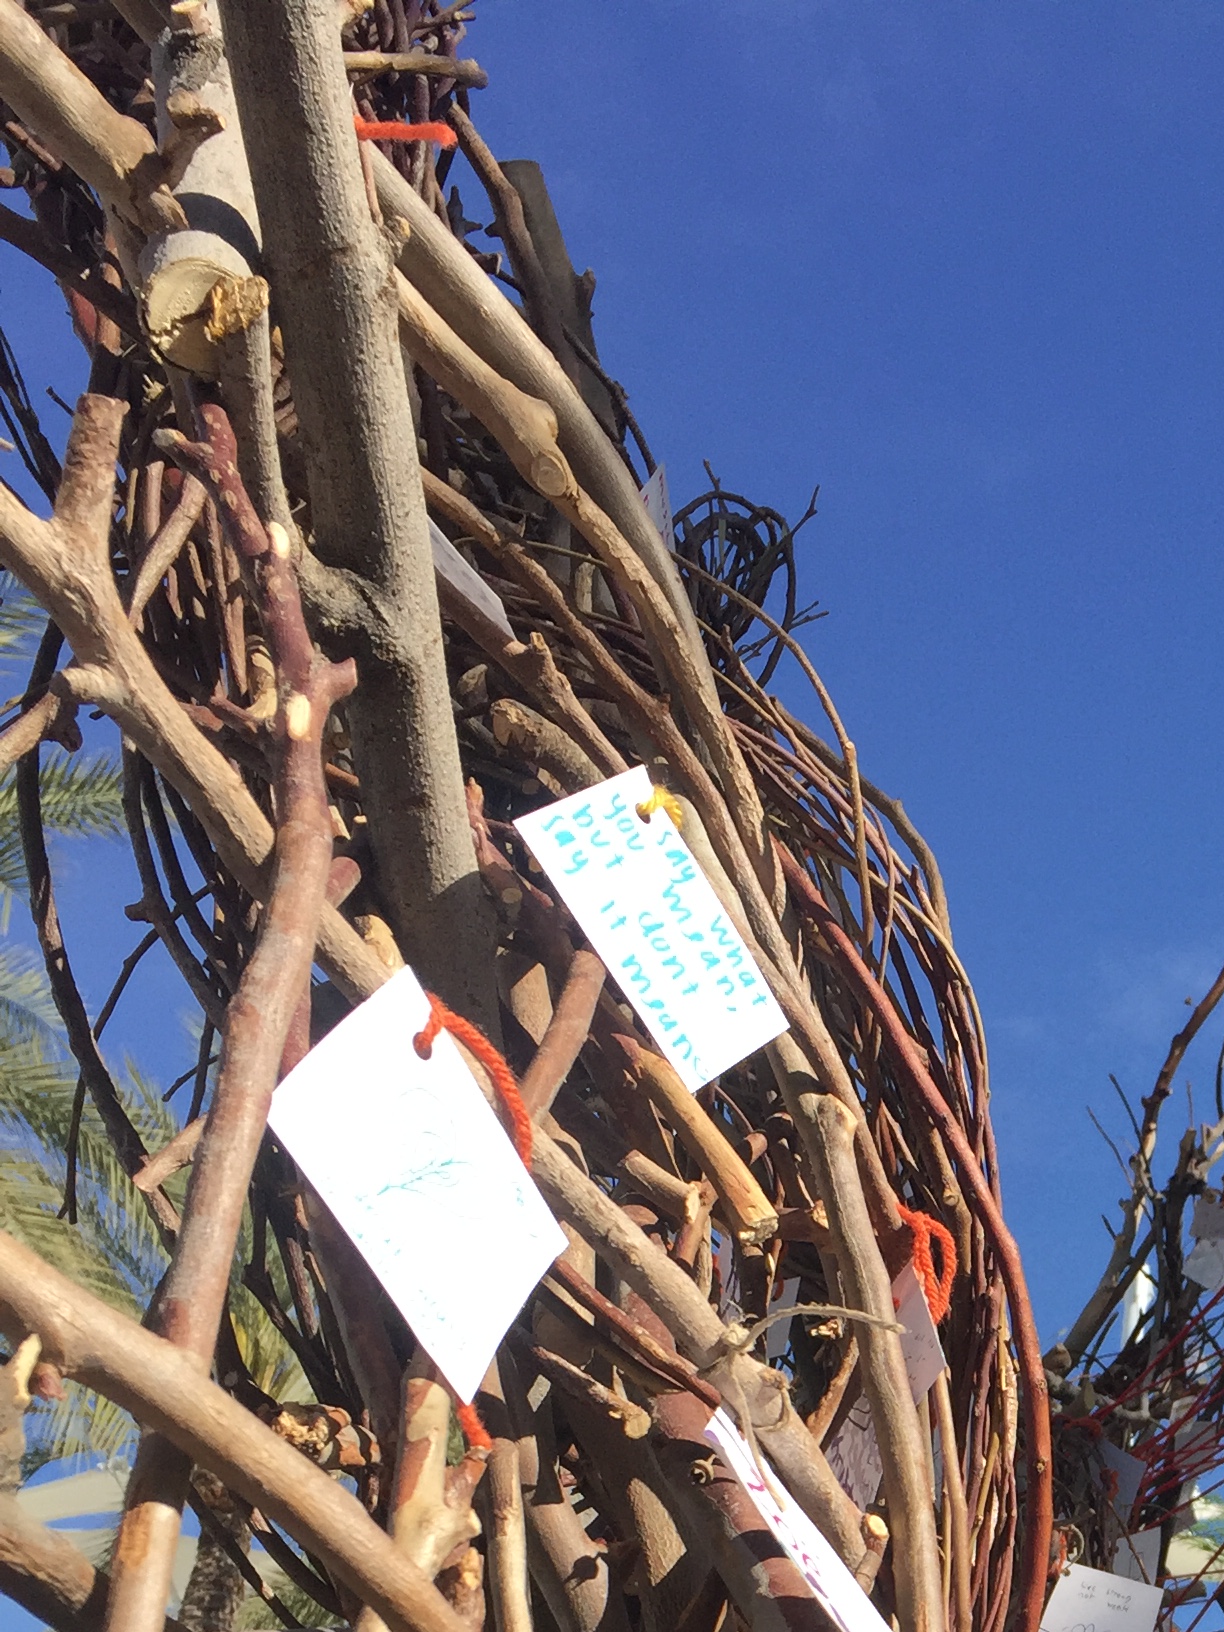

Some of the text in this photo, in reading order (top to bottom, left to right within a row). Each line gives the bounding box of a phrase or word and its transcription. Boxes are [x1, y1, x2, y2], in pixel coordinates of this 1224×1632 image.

[541, 814, 589, 876] say
[572, 803, 625, 869] but
[603, 793, 645, 851] you
[656, 830, 767, 1006] say what
